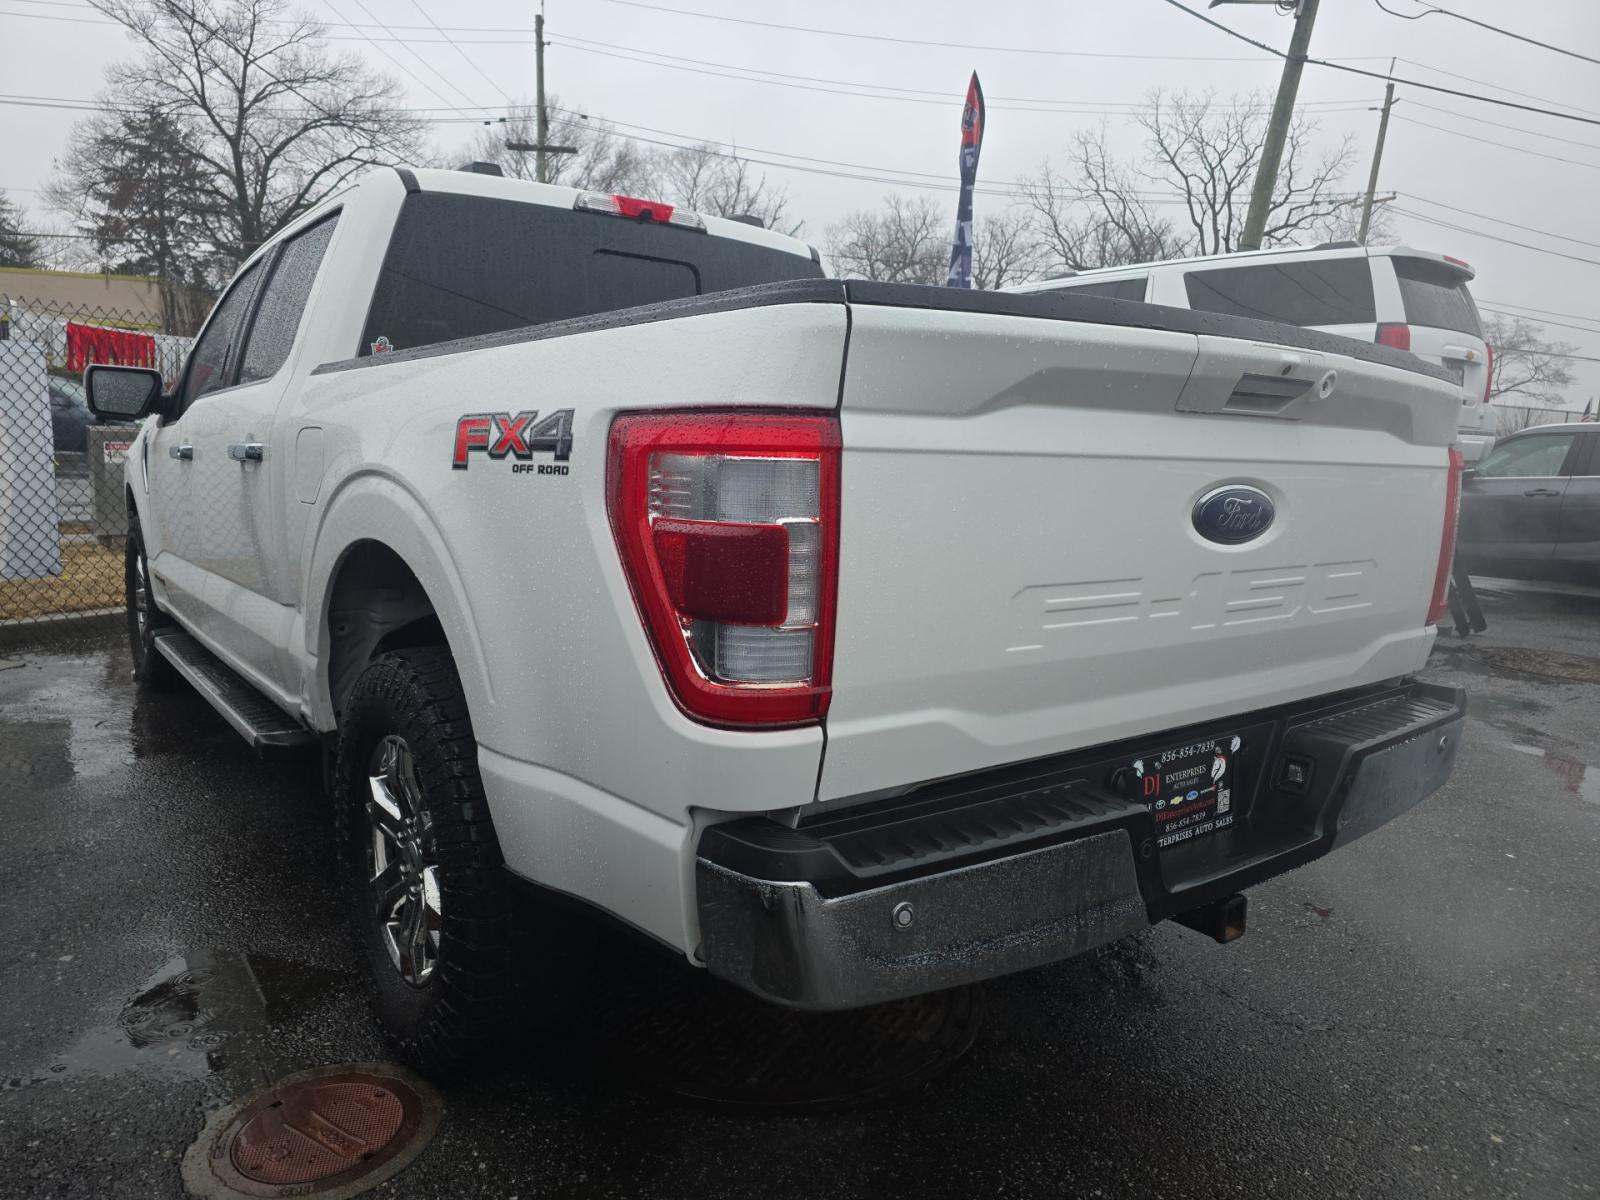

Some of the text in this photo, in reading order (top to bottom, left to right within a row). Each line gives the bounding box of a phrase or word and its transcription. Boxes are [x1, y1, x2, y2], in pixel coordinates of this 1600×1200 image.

[452, 408, 576, 471] FX4
[512, 464, 569, 476] OFF ROAD
[1217, 497, 1263, 529] Ford
[1005, 559, 1379, 652] F-150
[1161, 740, 1216, 763] 856-854-7839
[1144, 772, 1160, 797] DJ
[1165, 765, 1207, 784] ENTERPRISES
[1194, 822, 1214, 836] AUTO
[1215, 815, 1233, 829] SALES
